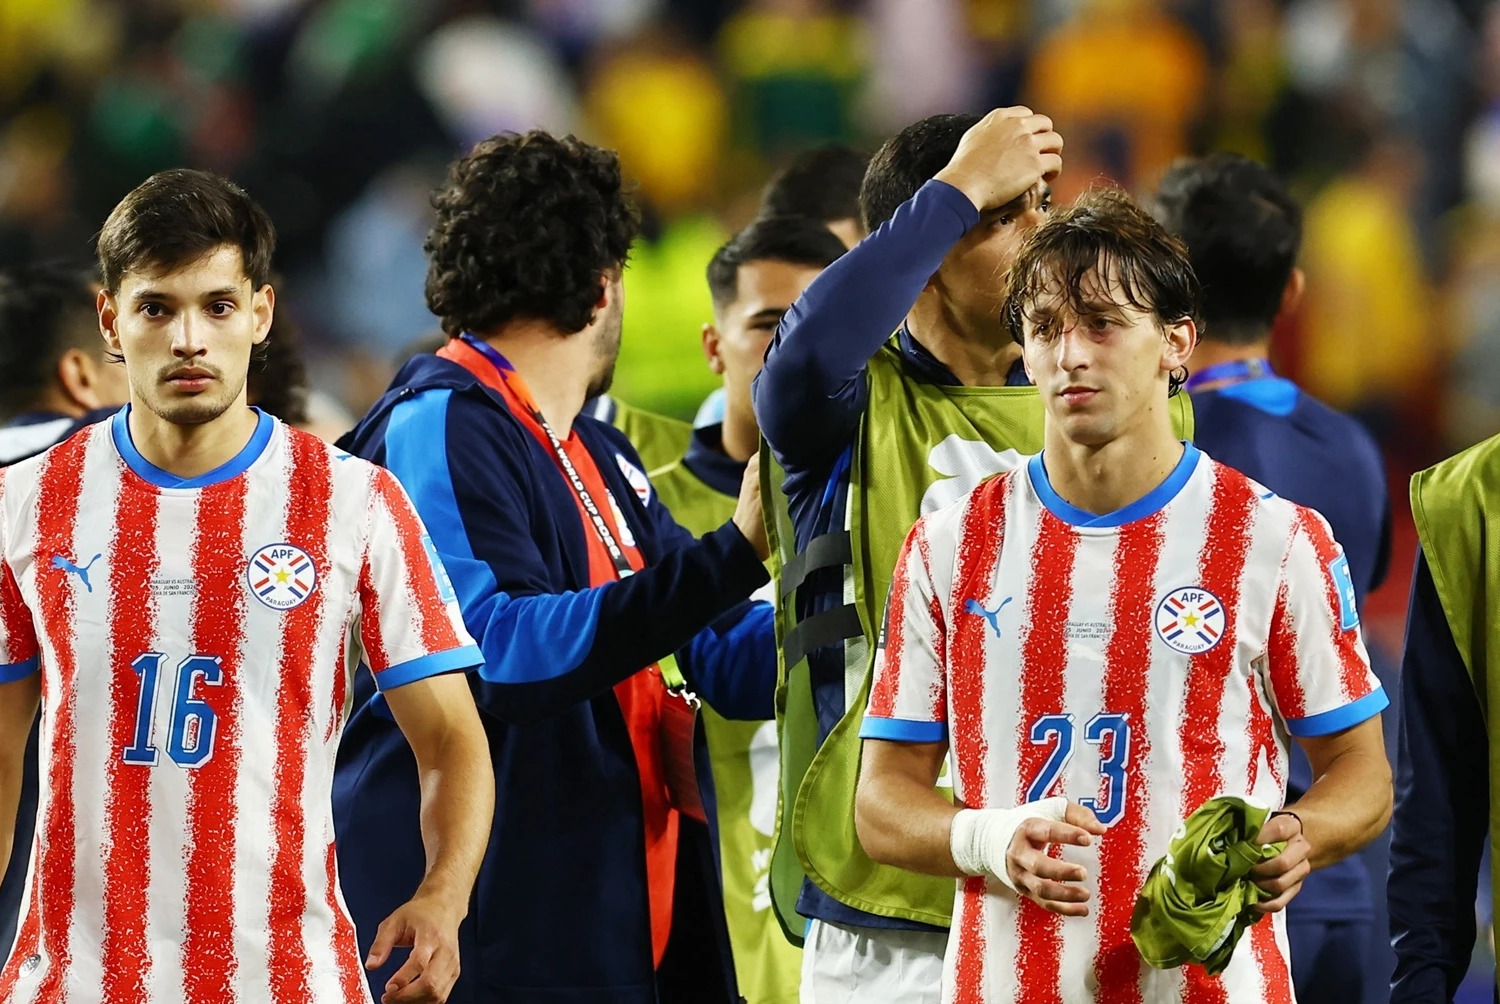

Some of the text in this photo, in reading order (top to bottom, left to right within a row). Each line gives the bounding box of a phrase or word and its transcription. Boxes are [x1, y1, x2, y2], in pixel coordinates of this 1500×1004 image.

[557, 448, 584, 491] WORLD
[579, 490, 598, 517] CUP
[270, 549, 294, 559] APF
[265, 596, 297, 607] PARAGUAY
[1180, 592, 1205, 604] APF
[1172, 640, 1205, 651] PARAGUAY
[122, 652, 223, 769] 16
[1025, 712, 1132, 828] 23
